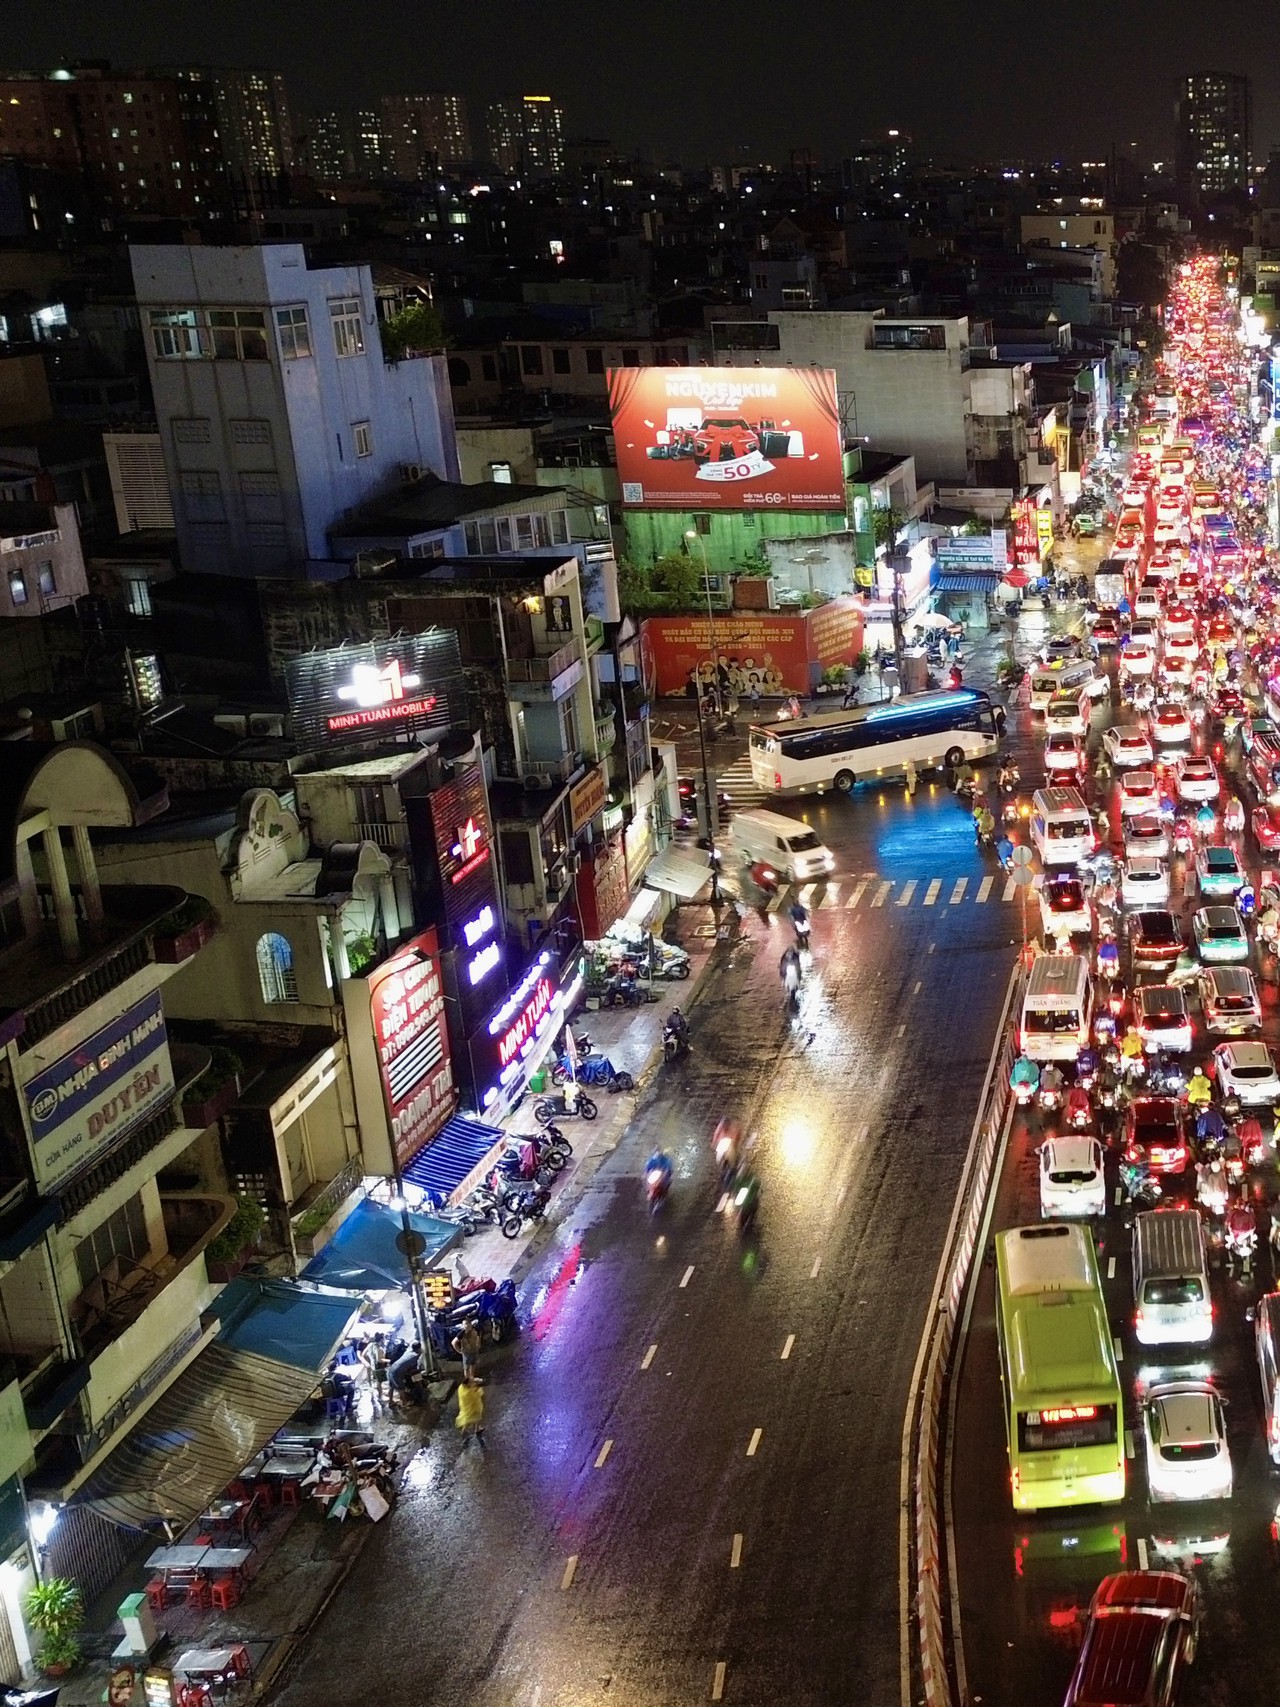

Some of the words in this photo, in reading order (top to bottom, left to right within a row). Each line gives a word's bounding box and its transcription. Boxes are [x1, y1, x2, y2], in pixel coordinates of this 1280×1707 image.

[724, 463, 751, 479] 50
[328, 714, 359, 731] MINH
[360, 707, 391, 724] TUAN
[501, 1015, 527, 1065] MINH
[58, 1062, 97, 1102] NHỰA
[88, 1064, 161, 1139] DUYÊN
